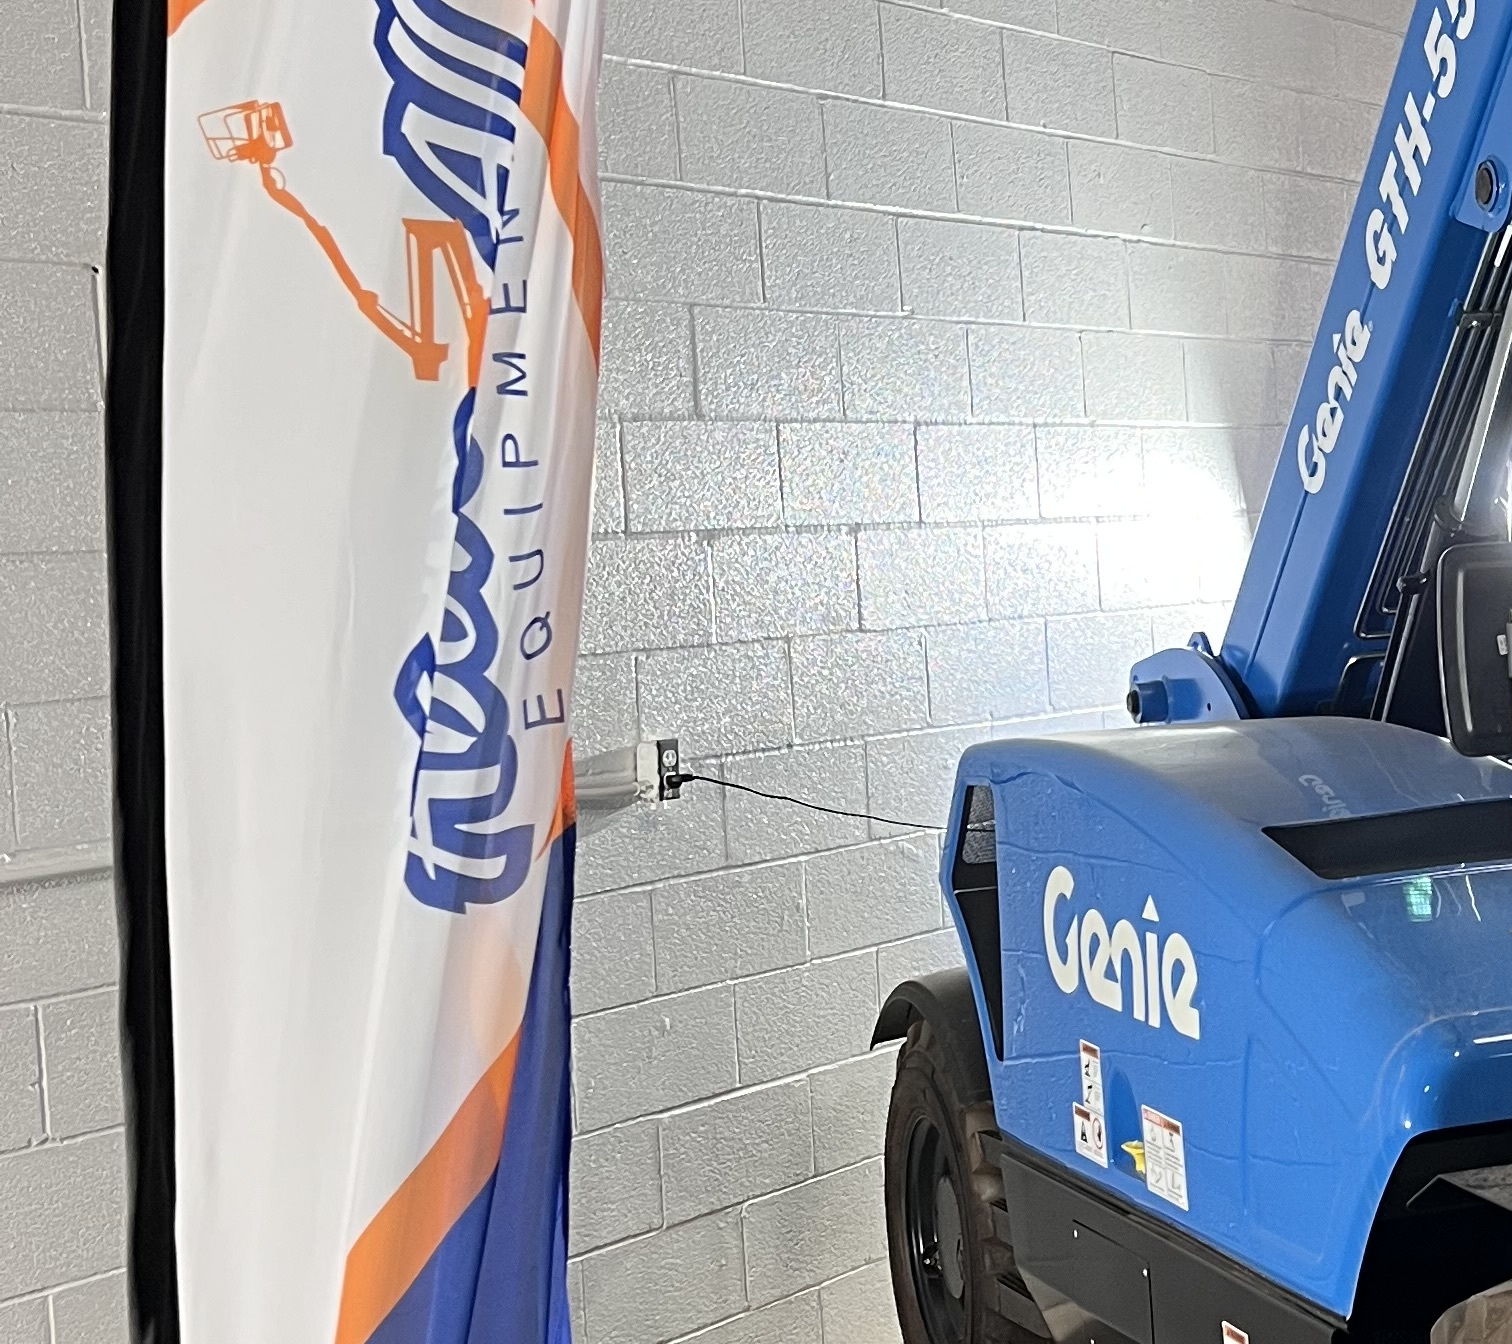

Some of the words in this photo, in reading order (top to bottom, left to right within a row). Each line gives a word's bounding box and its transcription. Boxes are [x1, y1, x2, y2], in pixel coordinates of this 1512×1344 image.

[490, 202, 566, 732] EQUIPMEN
[1297, 309, 1371, 495] Genie
[1043, 865, 1200, 1040] Genie
